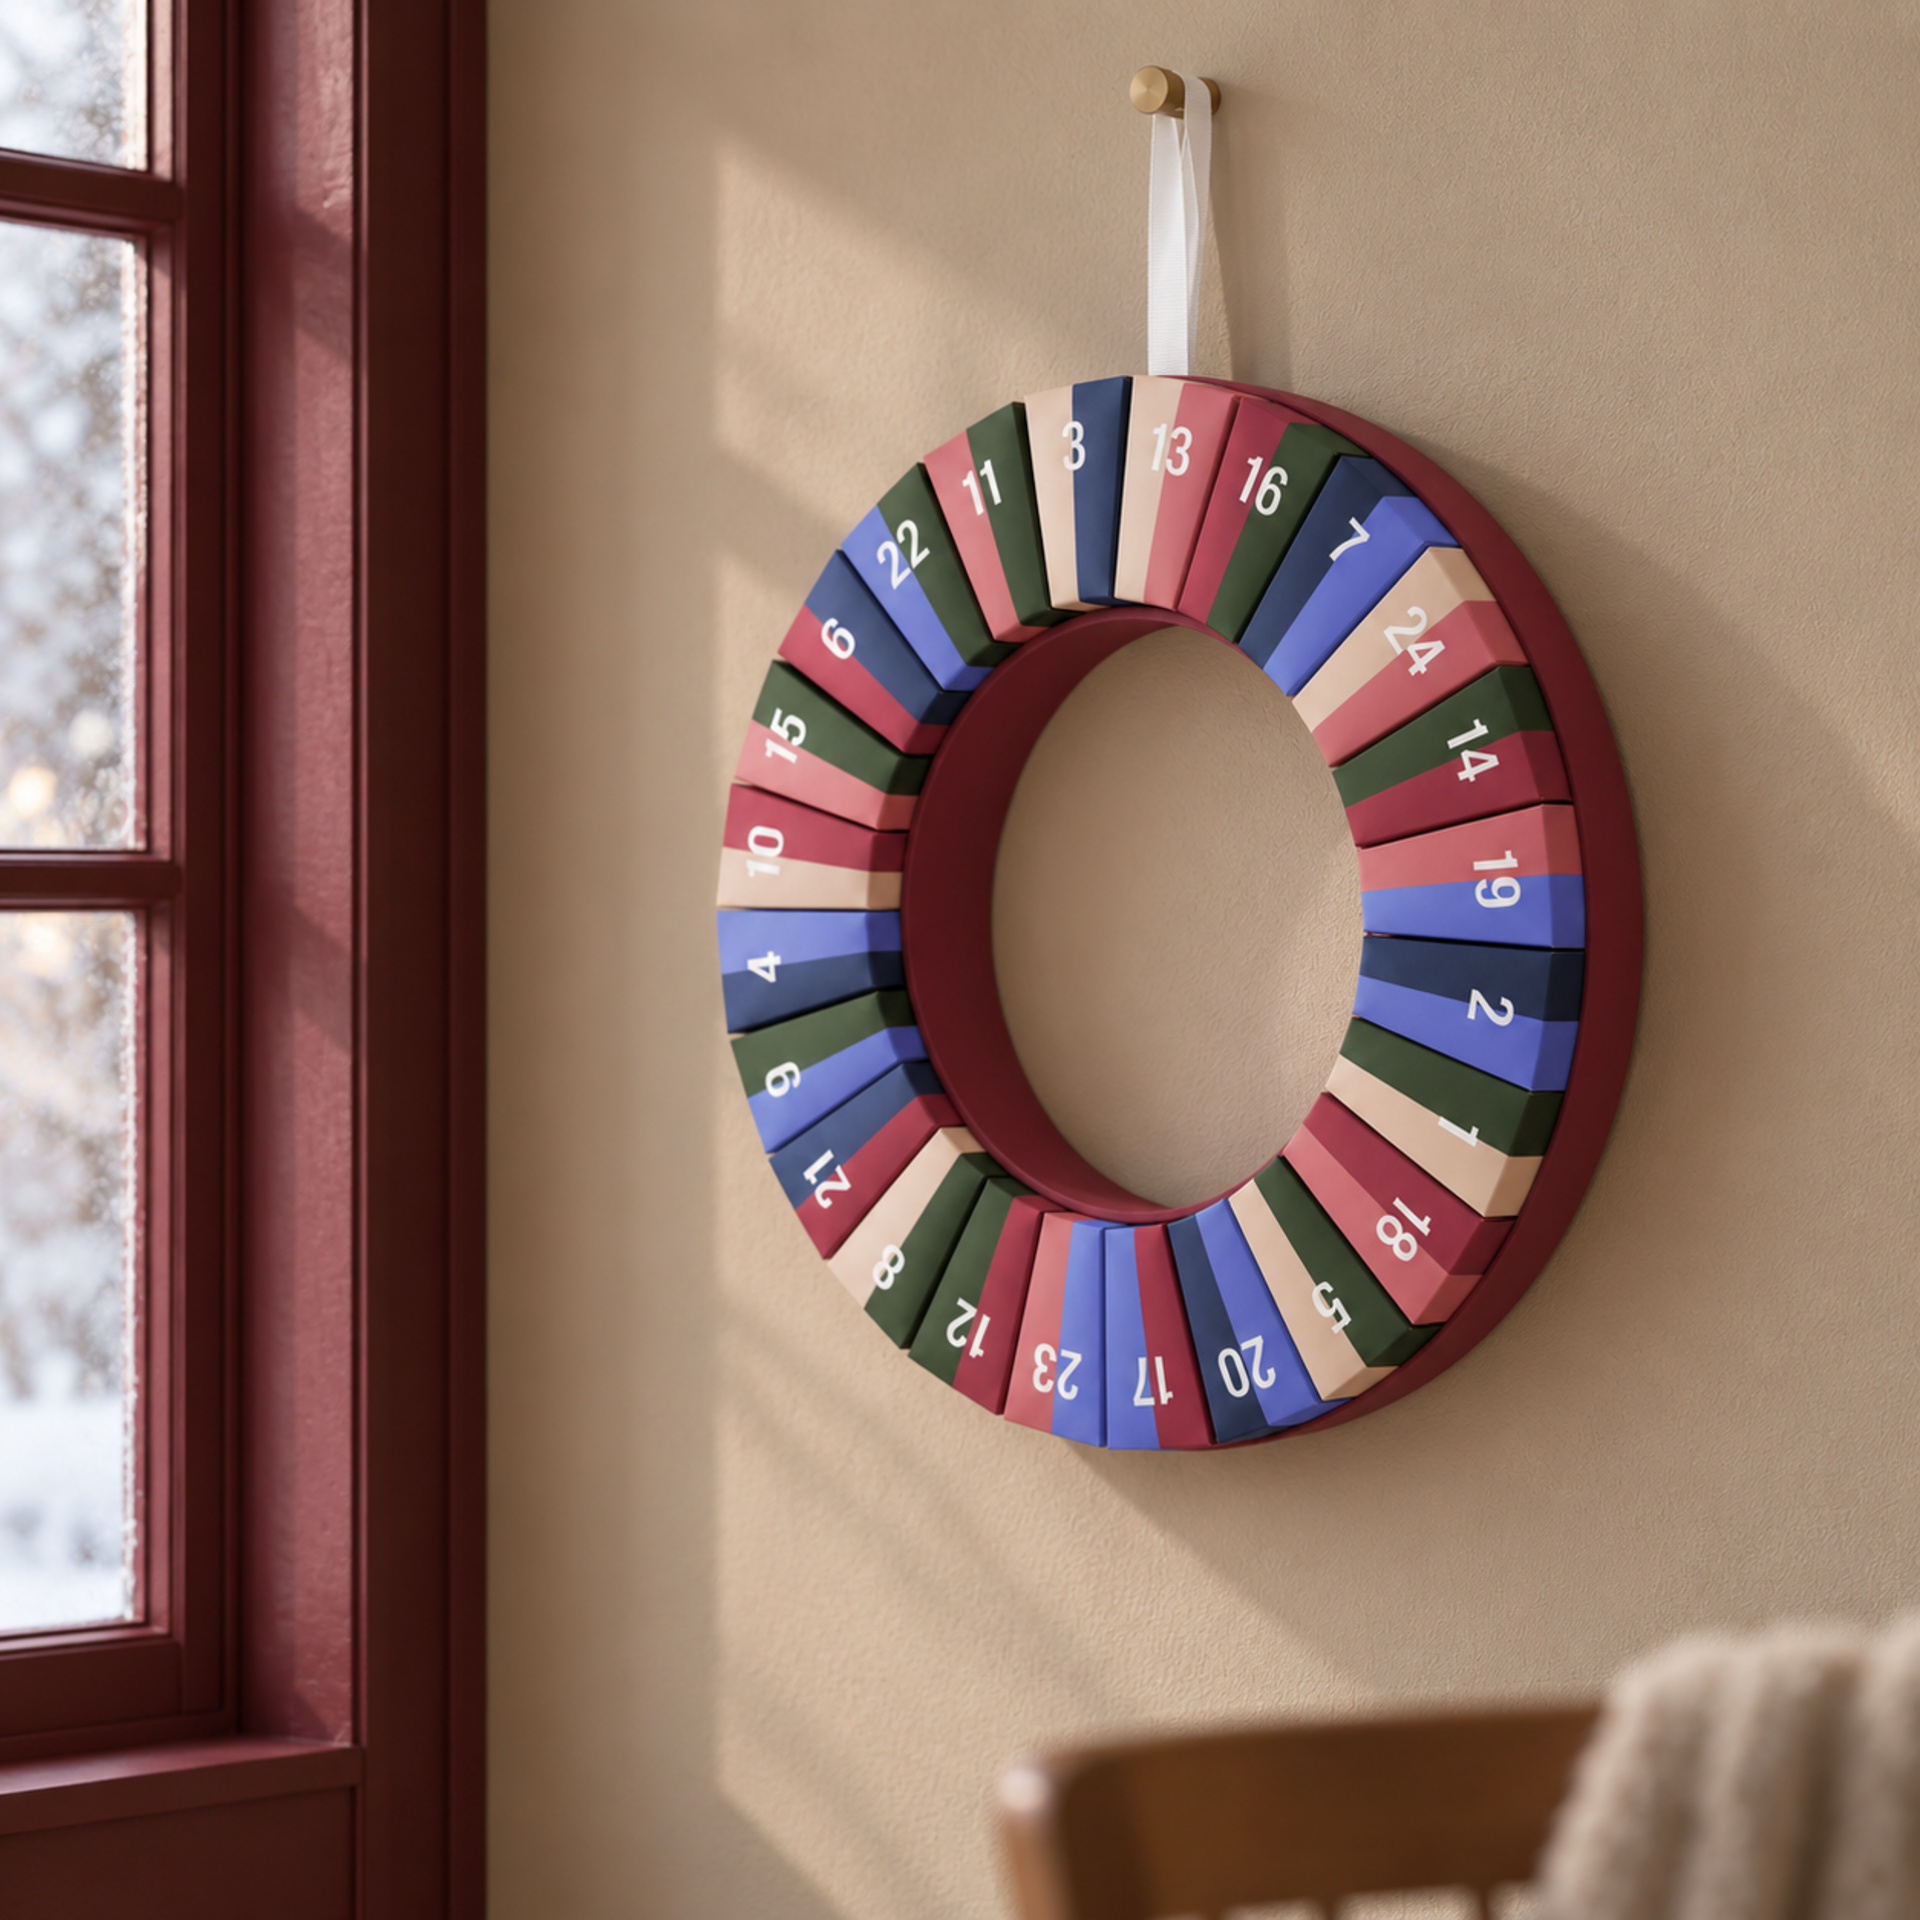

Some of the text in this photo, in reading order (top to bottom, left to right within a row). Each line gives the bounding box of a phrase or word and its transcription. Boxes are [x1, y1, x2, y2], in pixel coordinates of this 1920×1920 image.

[1061, 421, 1087, 470] 3
[1151, 423, 1193, 477] 13
[962, 459, 1003, 516] 11
[1238, 456, 1288, 516] 16
[876, 519, 930, 590] 22
[1329, 517, 1371, 562] 7
[820, 618, 856, 660] 6
[1383, 606, 1446, 677] 24
[765, 707, 807, 763] 15
[1447, 718, 1500, 783] 14
[746, 826, 785, 878] 10
[1473, 850, 1522, 909] 19
[747, 950, 782, 983] 4
[1466, 988, 1515, 1028] 2
[765, 1061, 802, 1098] 9
[1437, 1115, 1480, 1147] 1
[803, 1149, 852, 1210] 21
[1375, 1197, 1432, 1263] 18
[871, 1244, 906, 1291] 8
[946, 1297, 992, 1359] 12
[1311, 1280, 1352, 1334] 5
[1032, 1342, 1083, 1402] 23
[1133, 1356, 1174, 1407] 17
[1217, 1335, 1277, 1399] 20
